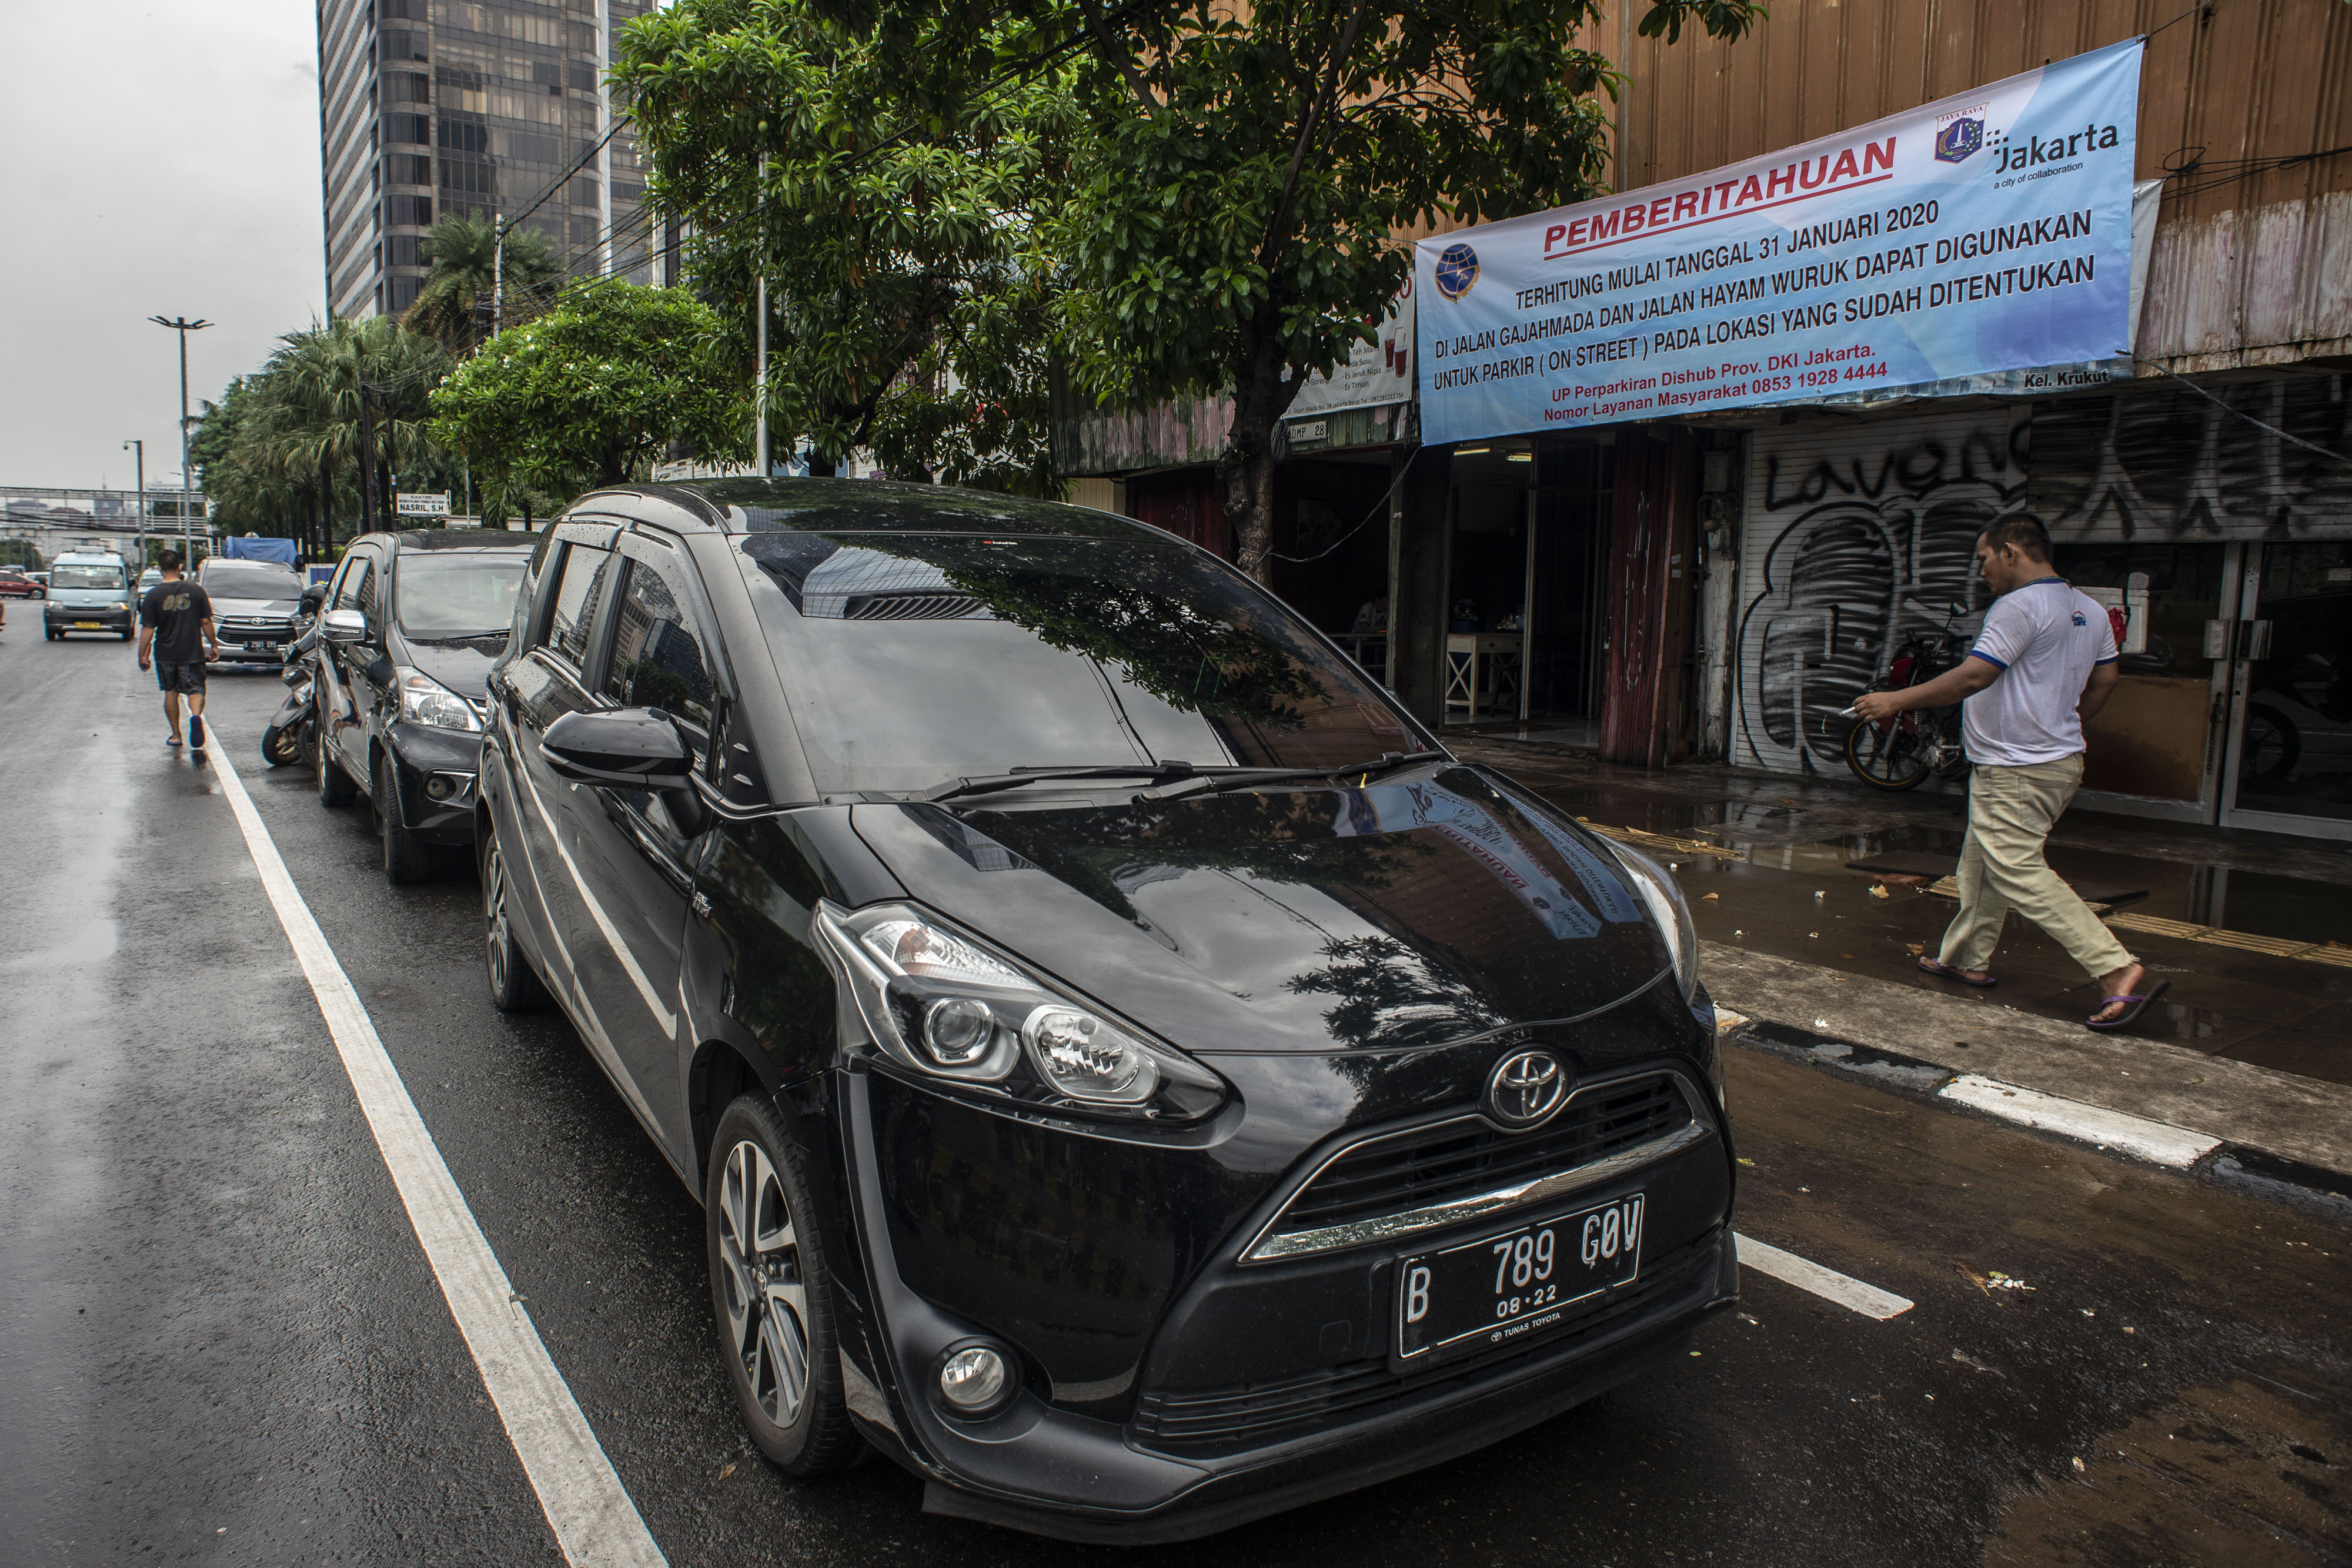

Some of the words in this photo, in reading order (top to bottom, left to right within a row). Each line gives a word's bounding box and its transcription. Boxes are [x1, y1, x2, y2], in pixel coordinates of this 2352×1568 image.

[1940, 112, 1959, 122] JAYA
[1962, 106, 1983, 116] RAYA
[2002, 178, 2015, 188] city
[2017, 173, 2027, 183] of
[2027, 162, 2083, 181] collaboration
[1544, 136, 1896, 252] PEMBERITAHUAN
[1515, 273, 1603, 310] TERHITUNG
[1608, 260, 1660, 292] MULAI
[1665, 240, 1753, 279] TANGGAL
[1759, 235, 1779, 259] 31
[1786, 211, 1879, 254] JANUARI
[1886, 199, 1939, 233] 2020
[1435, 339, 1448, 359] DI
[1452, 329, 1495, 356] JALAN
[1499, 310, 1594, 347] GAJAHMADA
[1599, 302, 1634, 329] DAN
[1638, 290, 1695, 320] JALAN
[1700, 275, 1765, 310] HAYAM
[1770, 259, 1849, 296] WURUK
[1856, 242, 1929, 280] DAPAT
[1935, 208, 2092, 265] DIGUNAKAN
[1434, 365, 1479, 391] UNTUK
[1482, 355, 1534, 382] PARKIR
[1548, 349, 1571, 371] ON
[1576, 336, 1638, 367] STREET
[1653, 326, 1701, 355] PADA
[1706, 312, 1775, 346] LOKASI
[1780, 301, 1838, 333] YANG
[1844, 286, 1922, 322] SUDAH
[1929, 254, 2095, 308] DITENTUKAN
[1353, 347, 1362, 356] Teh
[1359, 358, 1372, 366] Susu
[1352, 370, 1366, 379] Jeruk
[1367, 367, 1382, 376] Nipis
[1352, 381, 1369, 389] Timun
[1552, 387, 1571, 402] UP
[1575, 377, 1656, 399] Perparkiran
[1661, 365, 1716, 387] Dishub
[1720, 360, 1762, 378] Prov.
[1768, 353, 1798, 372] DKI
[1803, 344, 1876, 366] Jakarta.
[2024, 373, 2053, 388] Kel.
[2057, 369, 2109, 386] Krukut
[1544, 406, 1589, 422] Nomor
[1592, 396, 1652, 417] Layanan
[1657, 381, 1747, 407] Masyarakat
[1751, 375, 1792, 394] 0853
[1797, 369, 1839, 388] 1928
[1843, 361, 1887, 382] 4444
[1315, 424, 1324, 436] 28
[400, 504, 430, 513] NASRIL,
[1407, 1266, 1431, 1323] B
[1494, 1229, 1555, 1294] 789
[1504, 1322, 1529, 1338] TUNAS
[1532, 1312, 1561, 1328] TOYOTA
